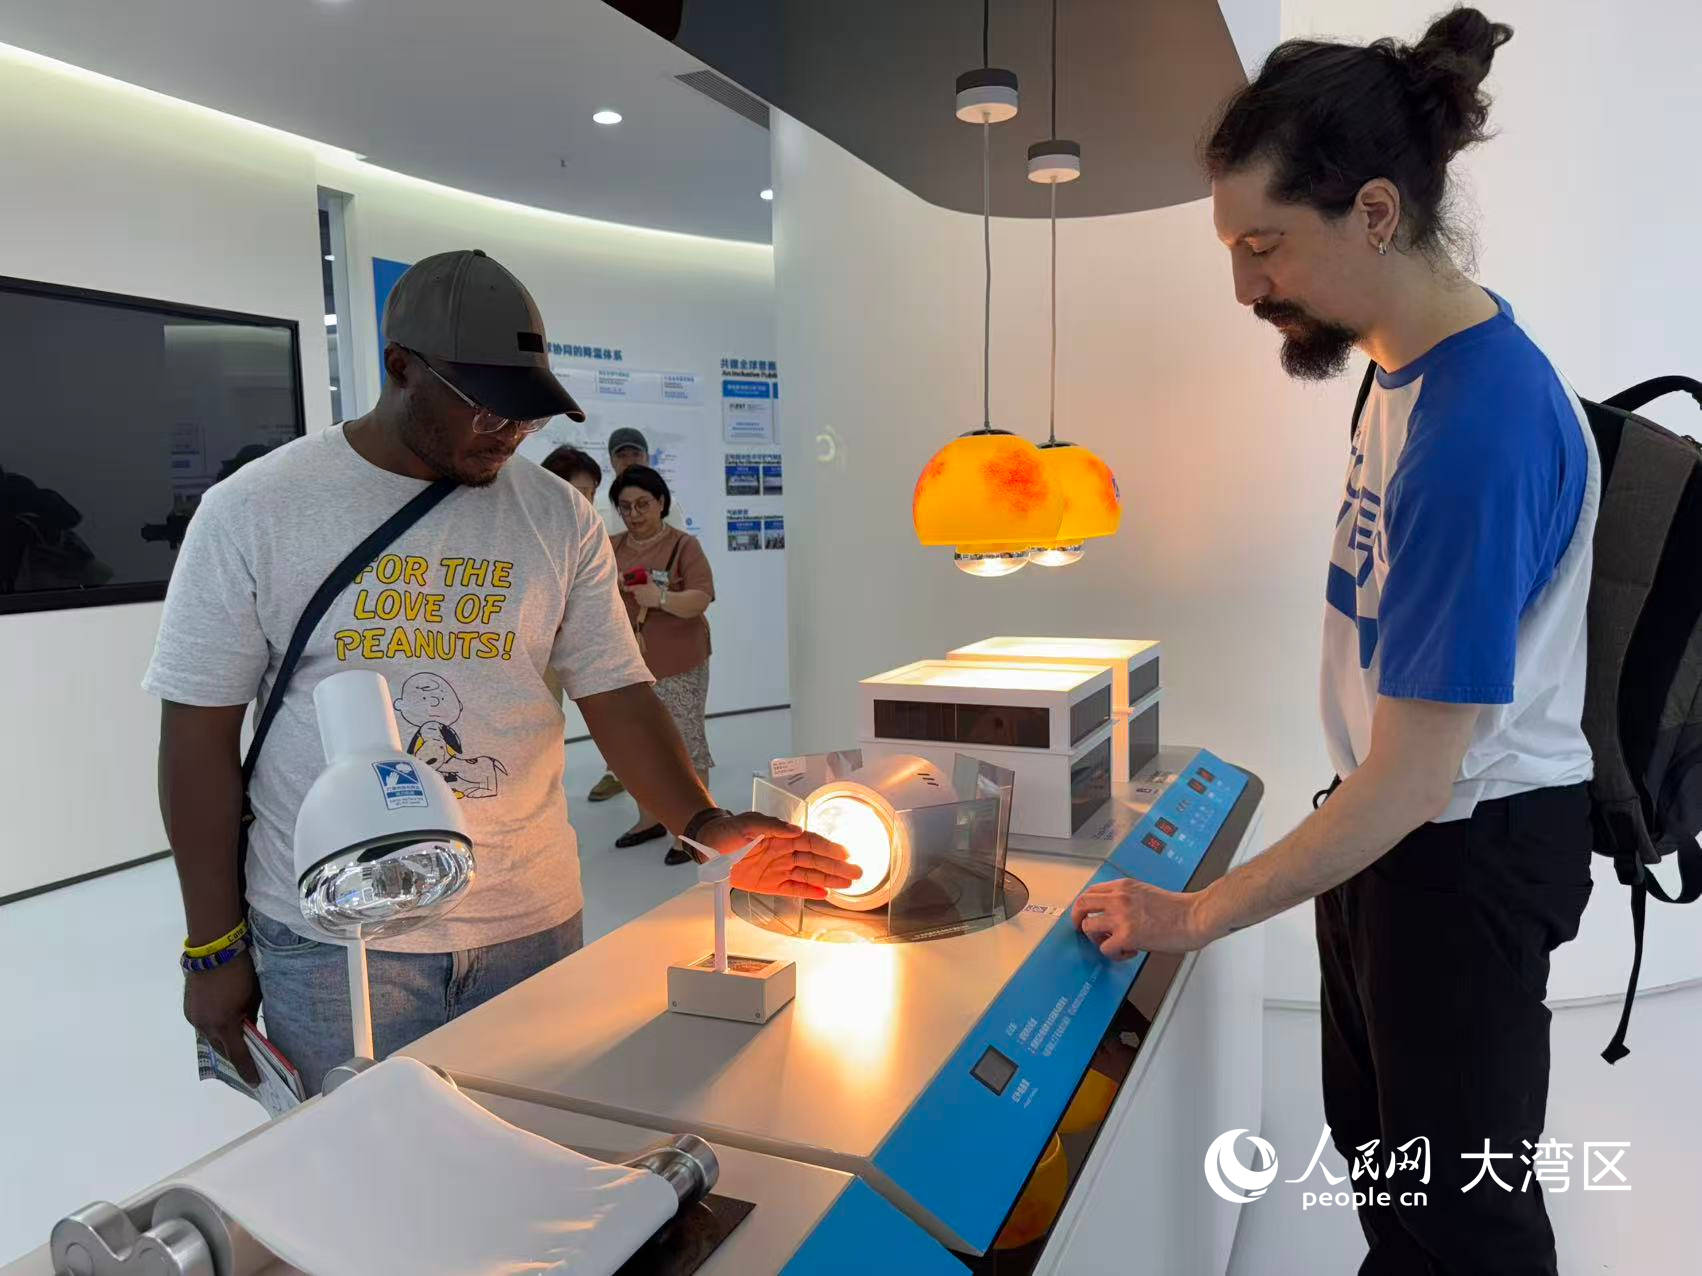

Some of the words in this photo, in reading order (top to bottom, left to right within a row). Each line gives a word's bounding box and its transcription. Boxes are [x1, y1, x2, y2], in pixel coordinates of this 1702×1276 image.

[441, 558, 513, 588] THE
[354, 589, 445, 623] LOVE
[455, 593, 506, 625] OF
[334, 626, 516, 661] PEANUTS!
